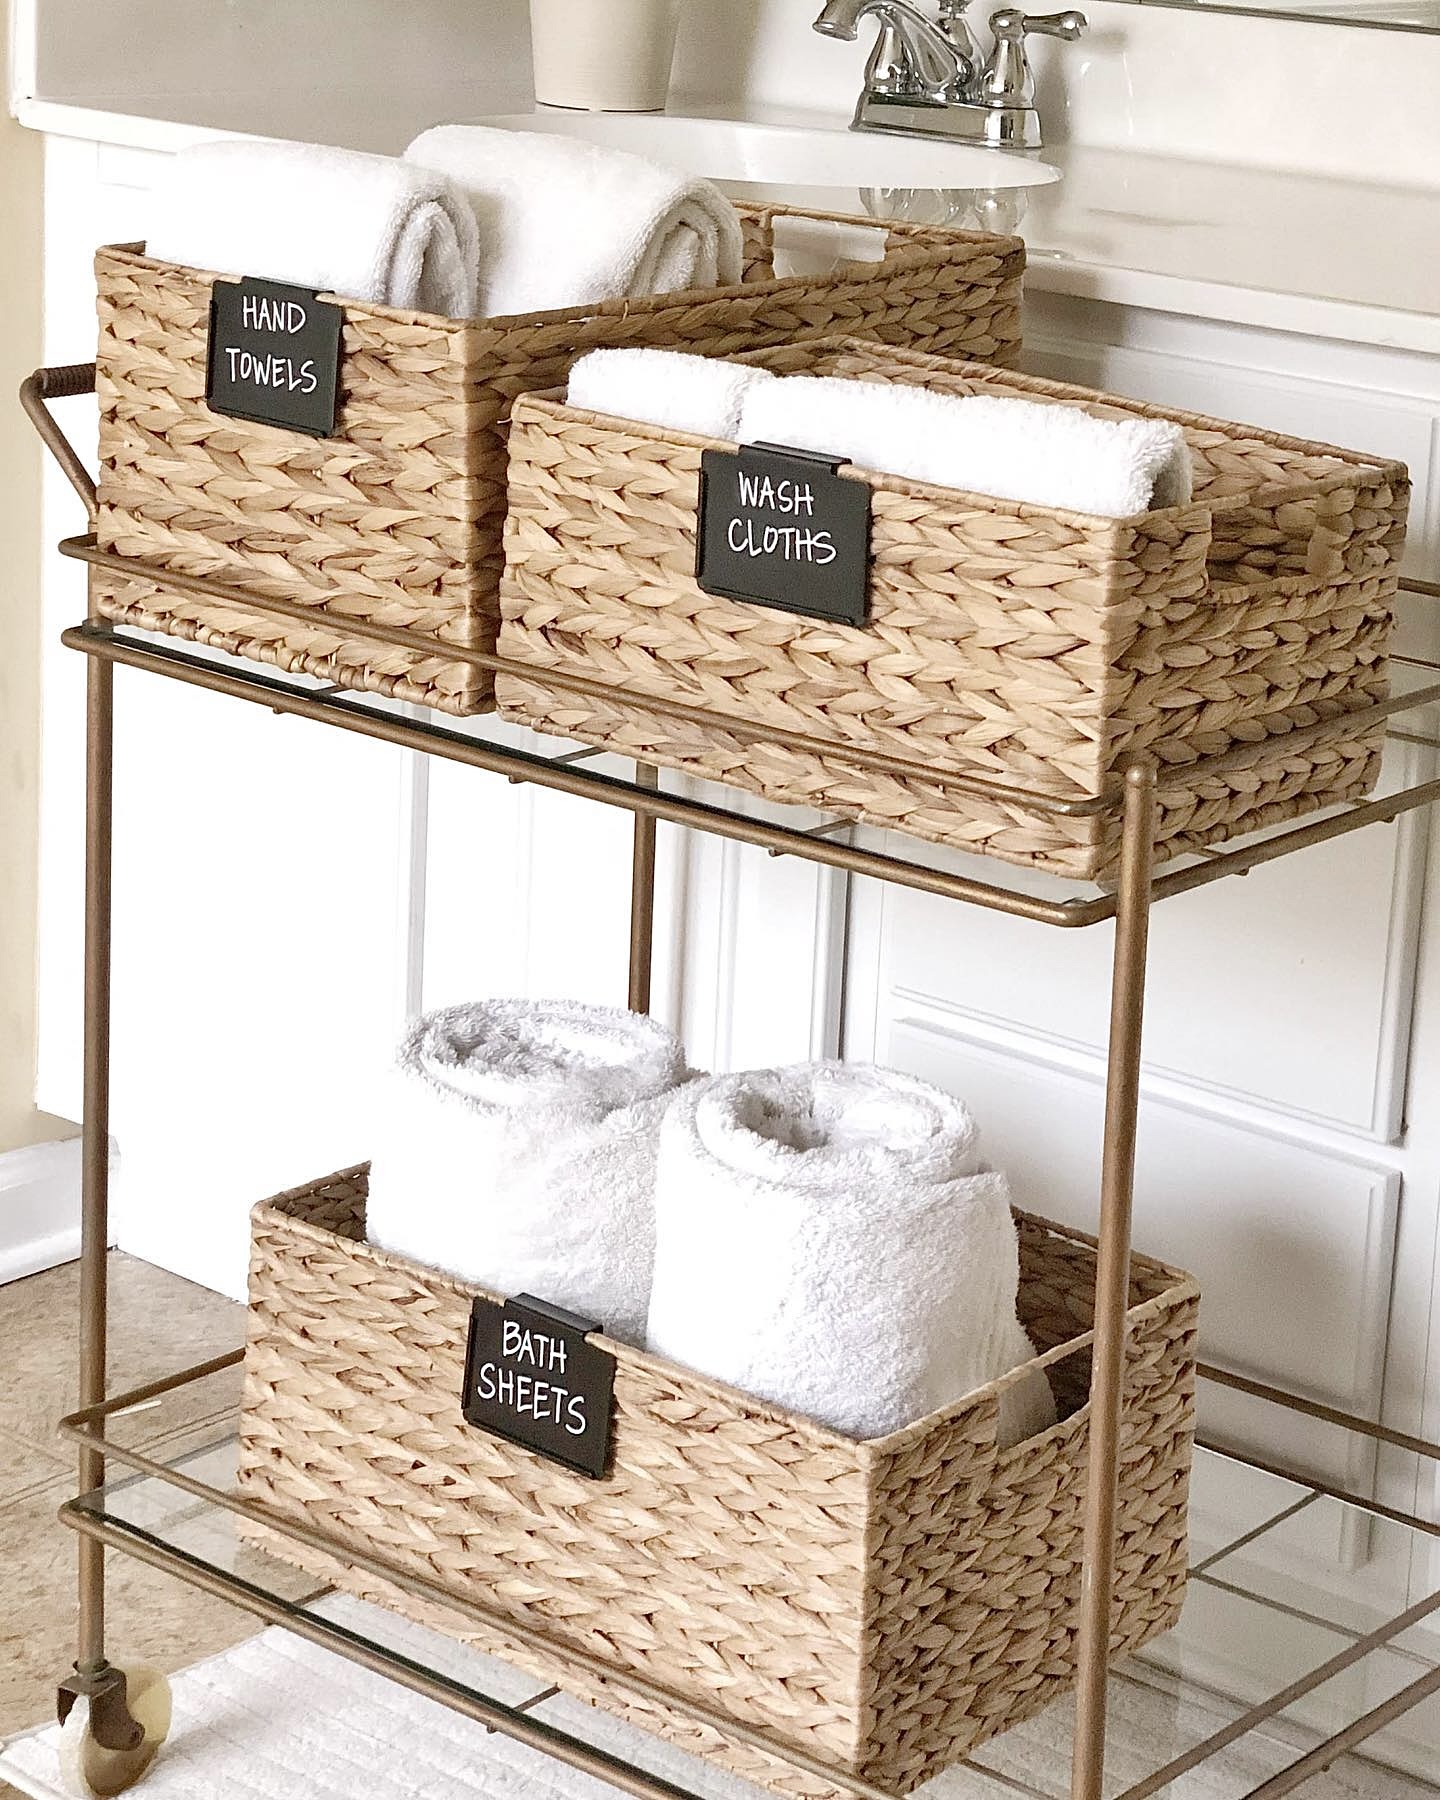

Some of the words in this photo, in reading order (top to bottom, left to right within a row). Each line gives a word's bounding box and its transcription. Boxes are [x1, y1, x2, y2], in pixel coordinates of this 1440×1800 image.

[242, 295, 306, 334] HAND
[225, 347, 318, 395] TOWELS
[738, 471, 815, 517] WASH
[727, 518, 837, 565] CLOTHS
[502, 1319, 568, 1374] BATH
[477, 1362, 586, 1435] SHEETS
